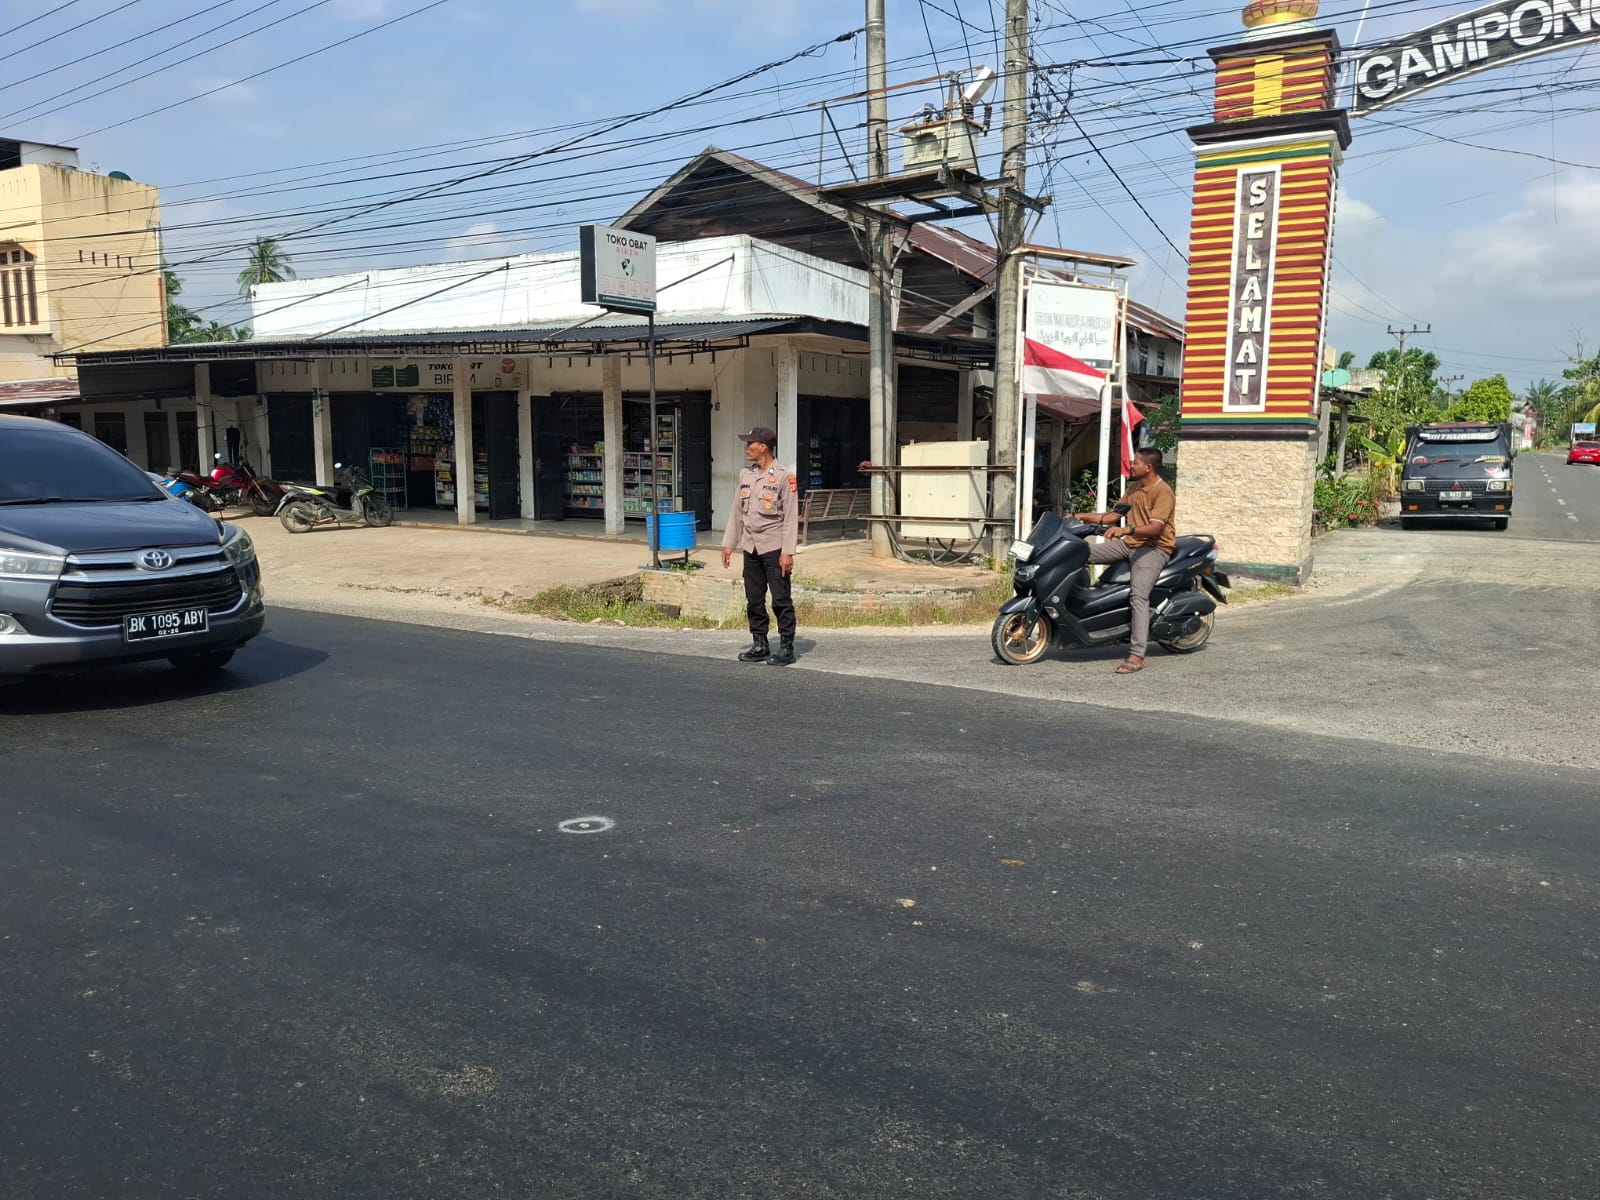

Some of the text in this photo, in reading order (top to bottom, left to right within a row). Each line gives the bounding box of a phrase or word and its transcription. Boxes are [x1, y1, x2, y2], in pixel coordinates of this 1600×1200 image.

[606, 233, 648, 251] TOKO OBAT
[1235, 177, 1267, 395] SELAMAT
[129, 609, 204, 632] BK 1095 ABY
